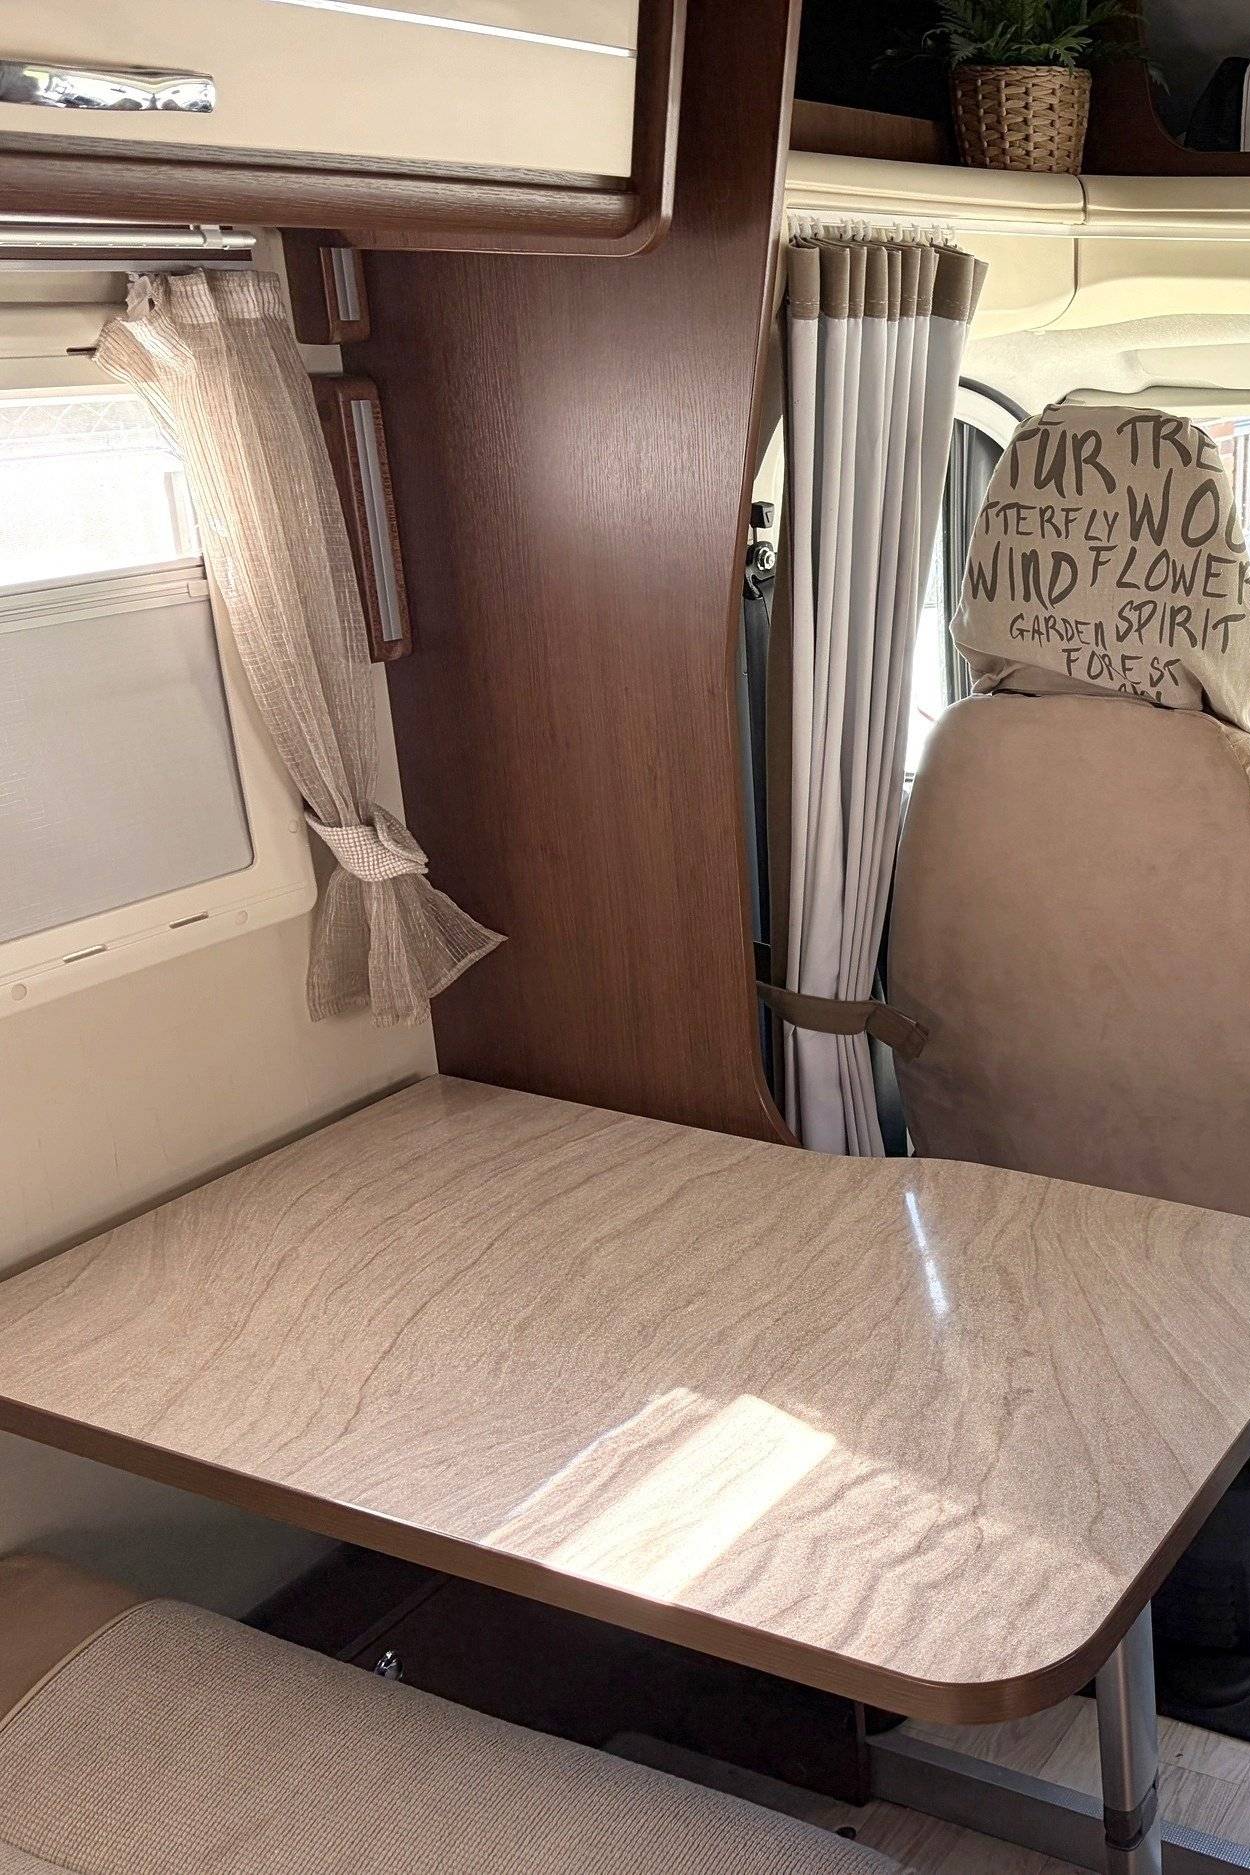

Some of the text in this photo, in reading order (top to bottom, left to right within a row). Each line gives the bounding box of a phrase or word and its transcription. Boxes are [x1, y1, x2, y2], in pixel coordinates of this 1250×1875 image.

[1010, 599, 1247, 654] GARDEN SPIRIT
[1061, 646, 1182, 687] FOREST
